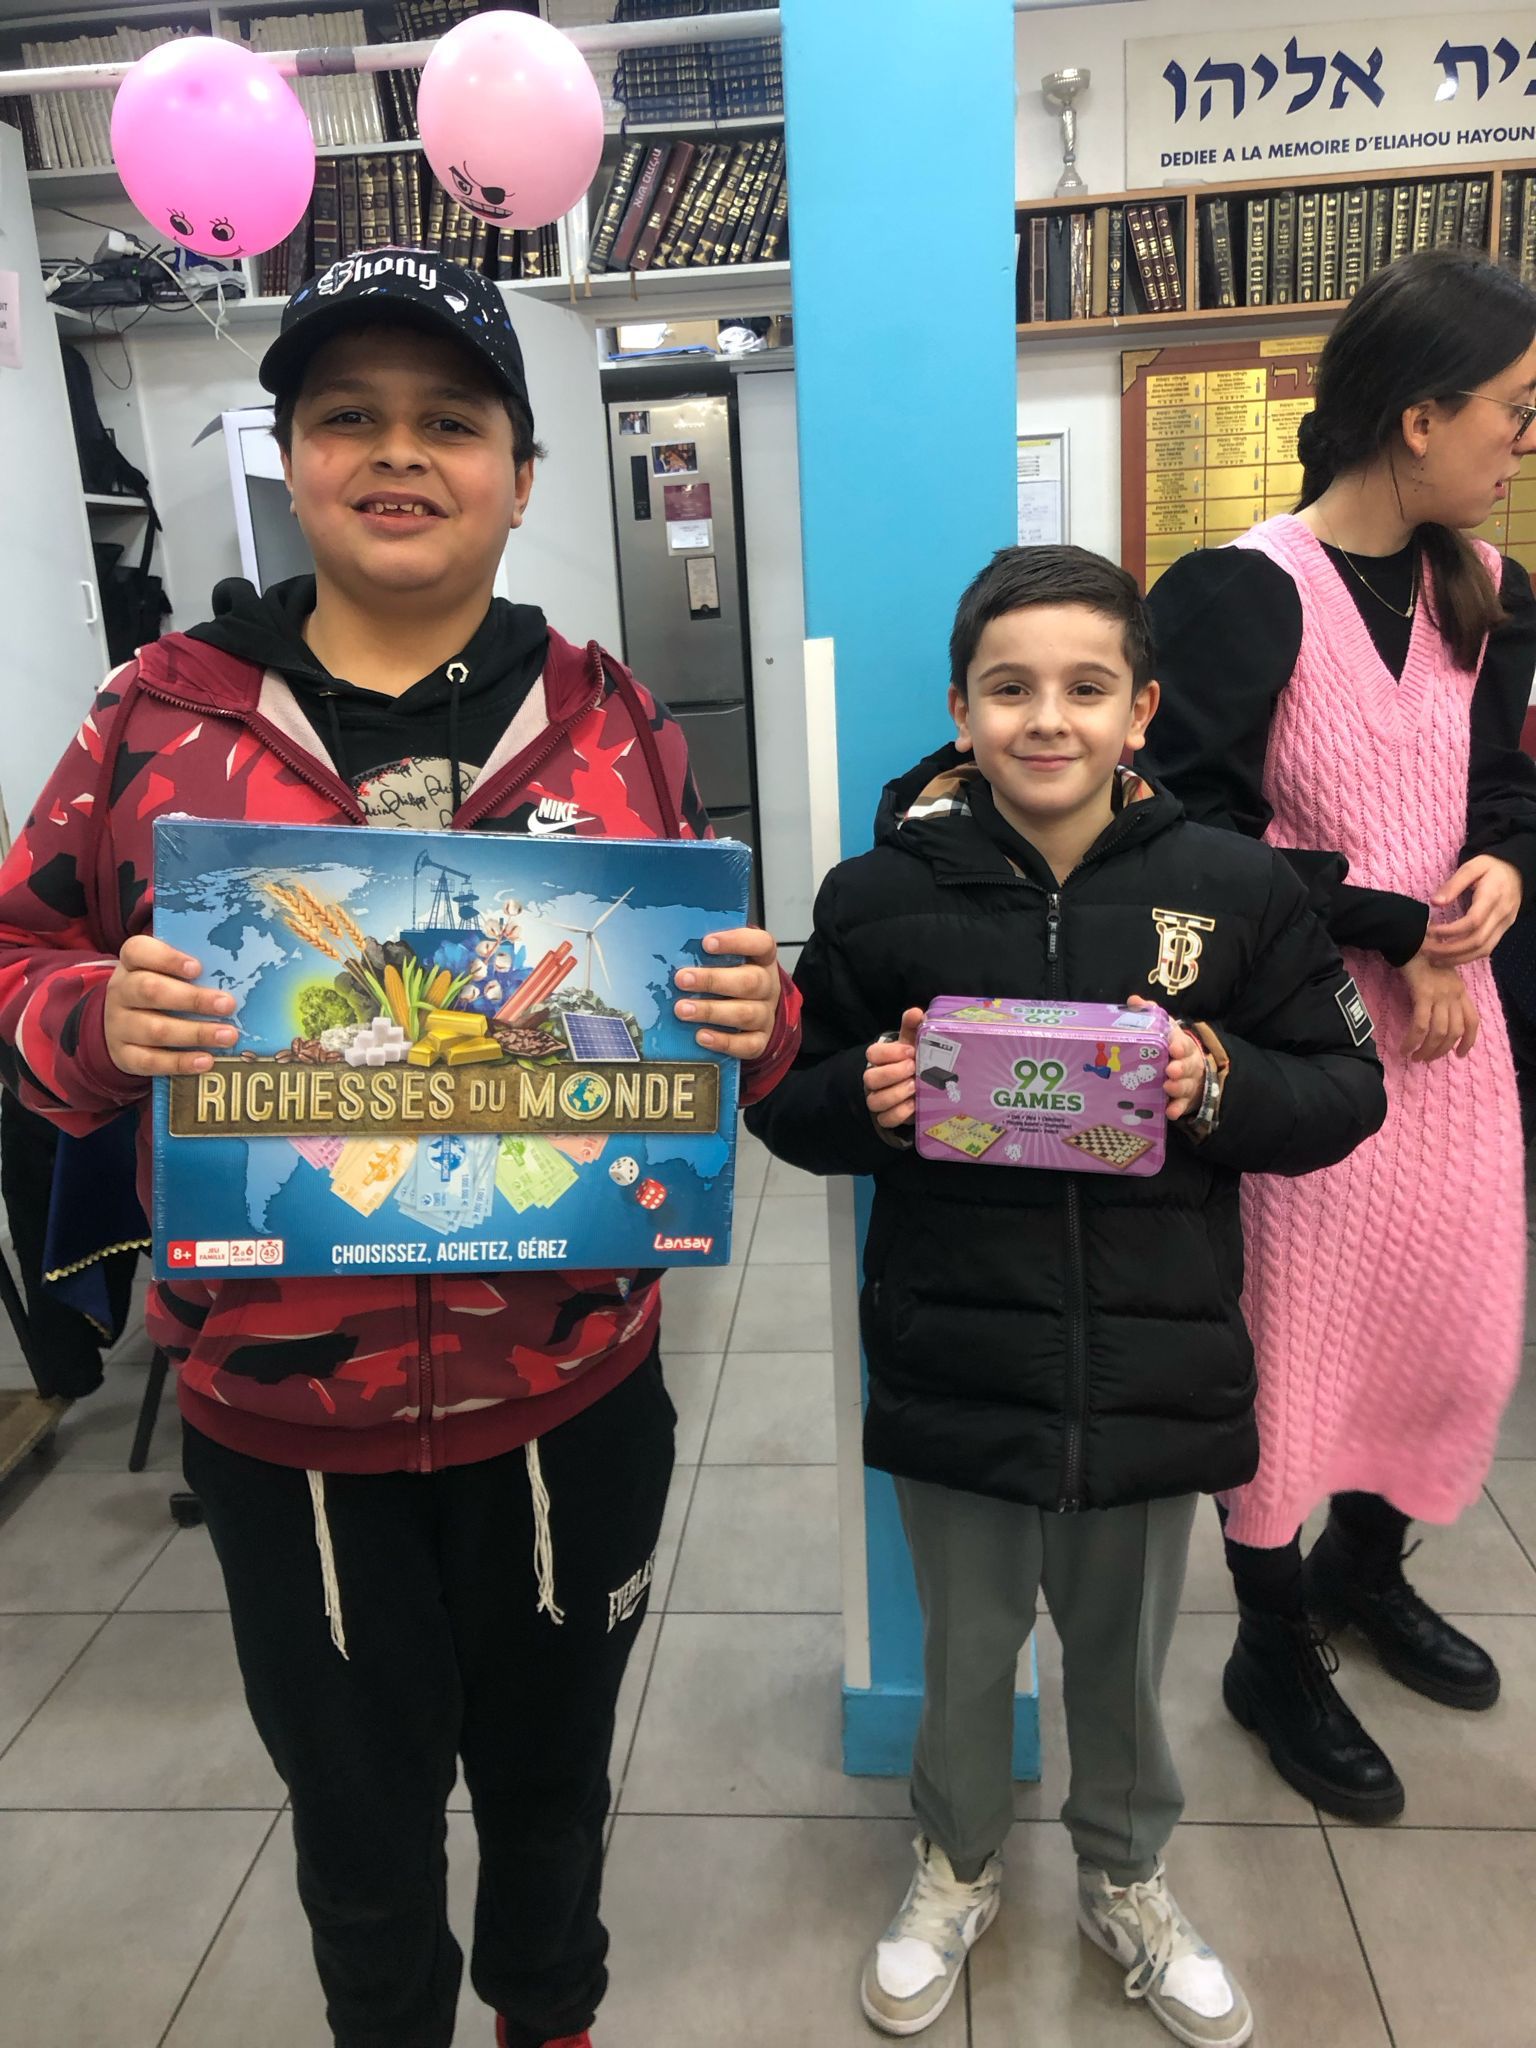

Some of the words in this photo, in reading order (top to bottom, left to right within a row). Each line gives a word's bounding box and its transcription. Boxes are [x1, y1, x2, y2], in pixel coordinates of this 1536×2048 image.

[1162, 35, 1386, 124] אליהו
[1433, 37, 1536, 102] ית
[1160, 149, 1217, 167] DEDIEE
[1222, 148, 1235, 163] A
[1241, 146, 1262, 161] LA
[1268, 139, 1350, 159] MEMOIRE
[1355, 131, 1451, 151] D'ELIAHOU
[1456, 126, 1536, 145] HAYOUN
[538, 796, 580, 822] NIKE
[1013, 1007, 1077, 1017] GAMES
[1140, 1047, 1160, 1060] 3+
[1013, 1059, 1065, 1092] 99
[197, 1071, 456, 1123] RICHESSES
[469, 1079, 506, 1113] DU
[518, 1070, 697, 1122] MONDE
[992, 1090, 1083, 1112] GAMES
[172, 1247, 193, 1260] 8+
[232, 1245, 239, 1257] 2
[246, 1245, 254, 1256] 6
[263, 1249, 276, 1258] 45
[331, 1242, 432, 1265] CHOISISSEZ,
[436, 1240, 513, 1263] ACHETEZ,
[517, 1236, 568, 1260] GÉREZ
[653, 1232, 713, 1254] Lansay
